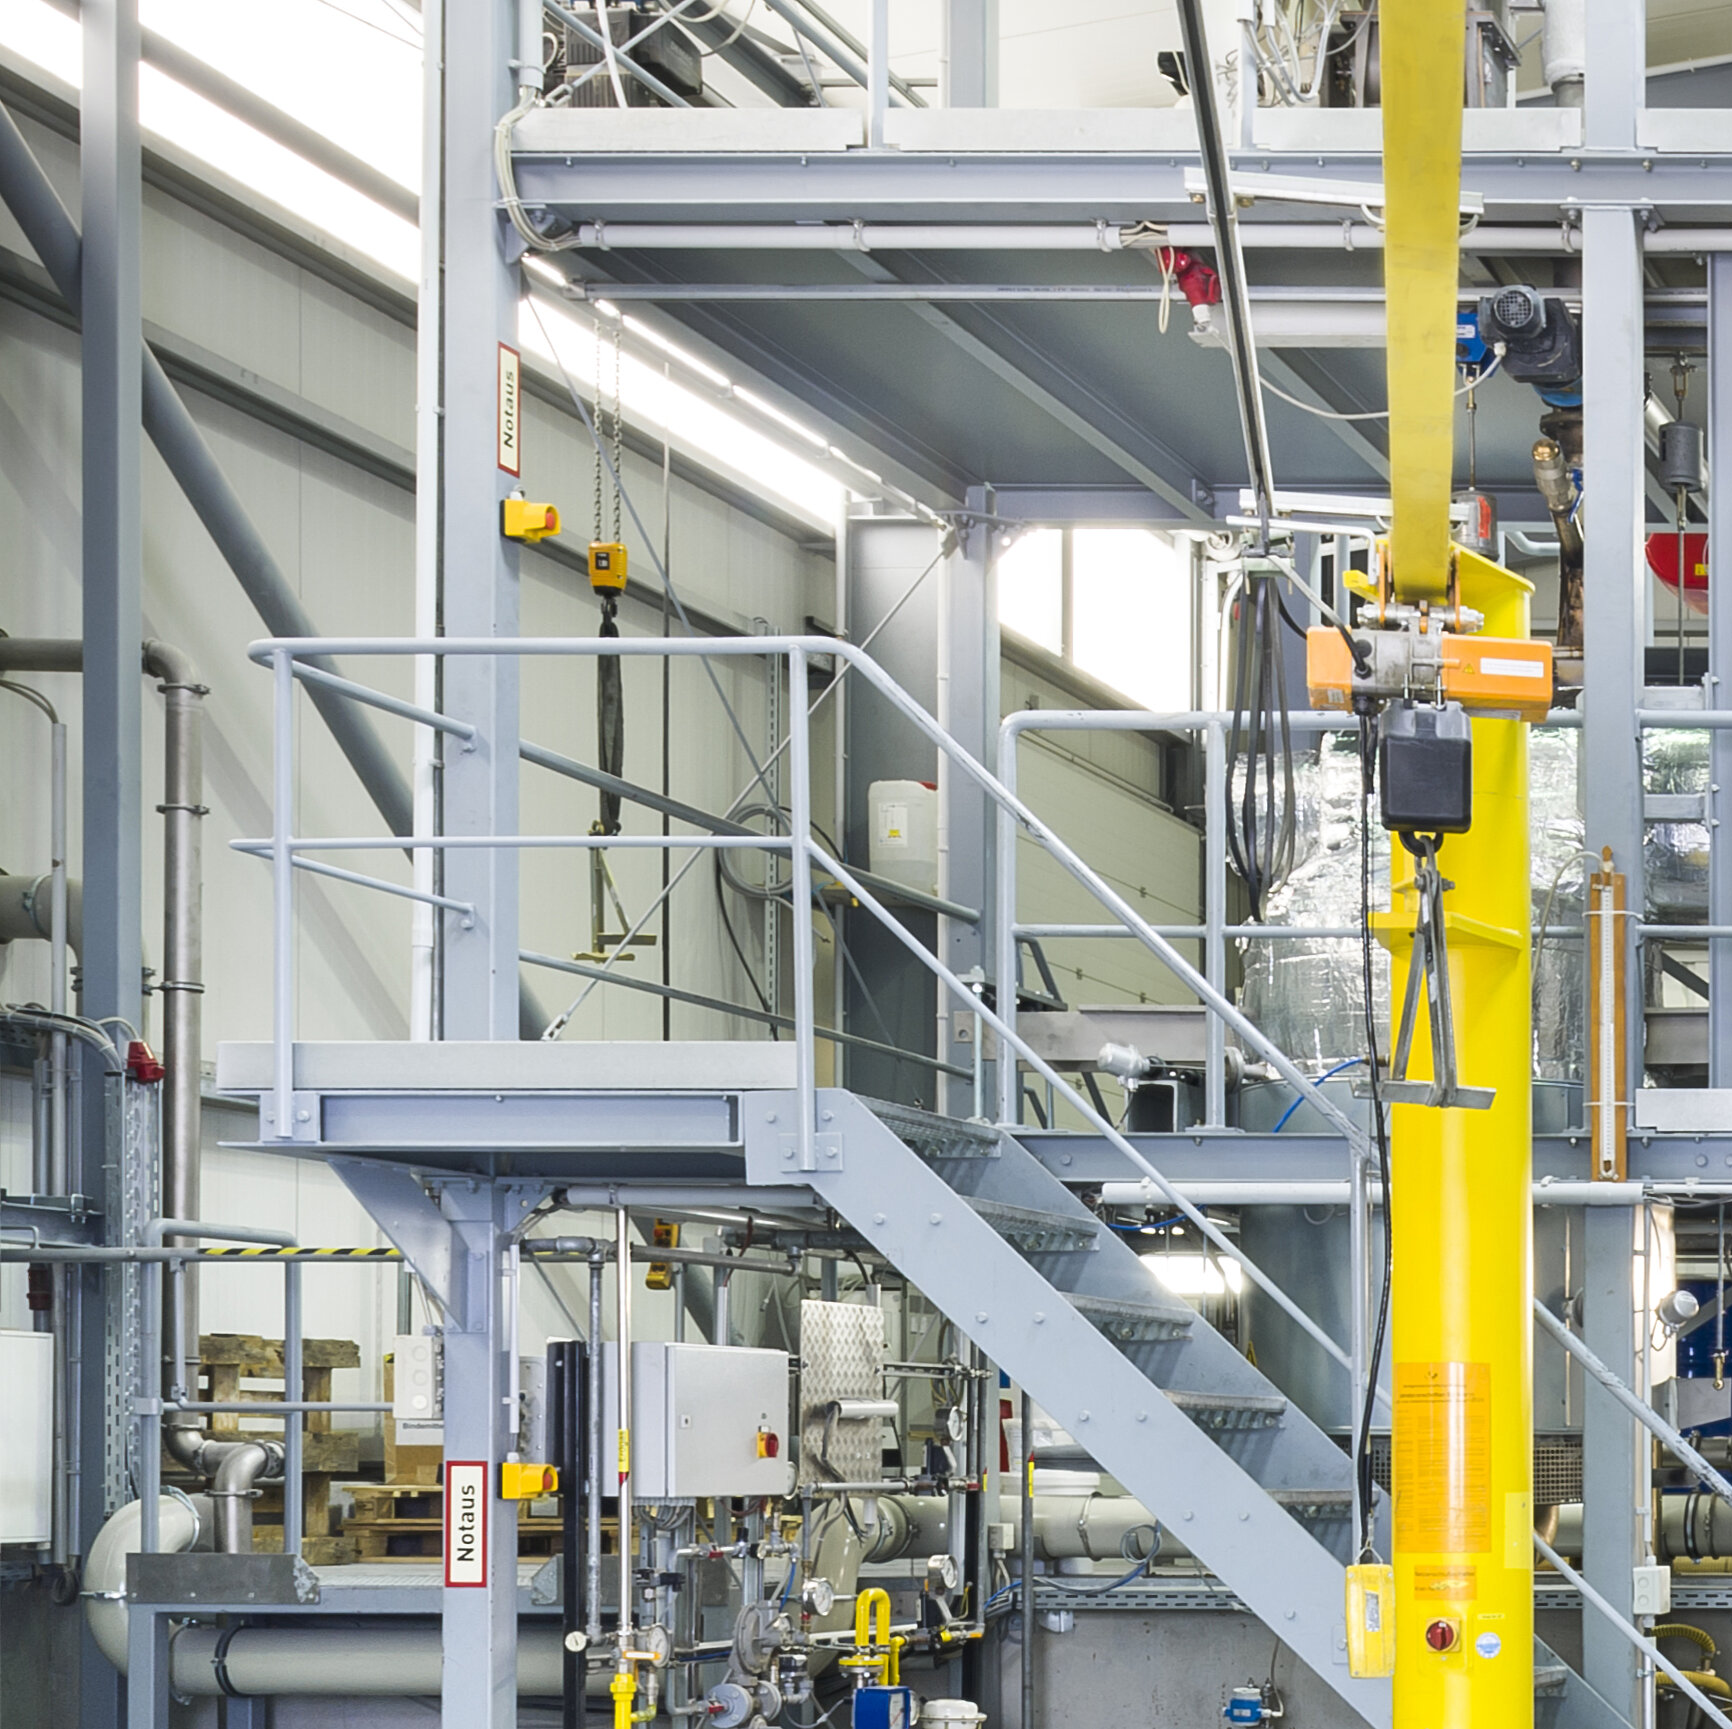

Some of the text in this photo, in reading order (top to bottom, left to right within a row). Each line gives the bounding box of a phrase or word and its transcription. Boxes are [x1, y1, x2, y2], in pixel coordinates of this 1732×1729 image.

[503, 371, 514, 448] Notaus
[403, 1422, 444, 1430] Bindemitte
[457, 1484, 475, 1562] Notaus
